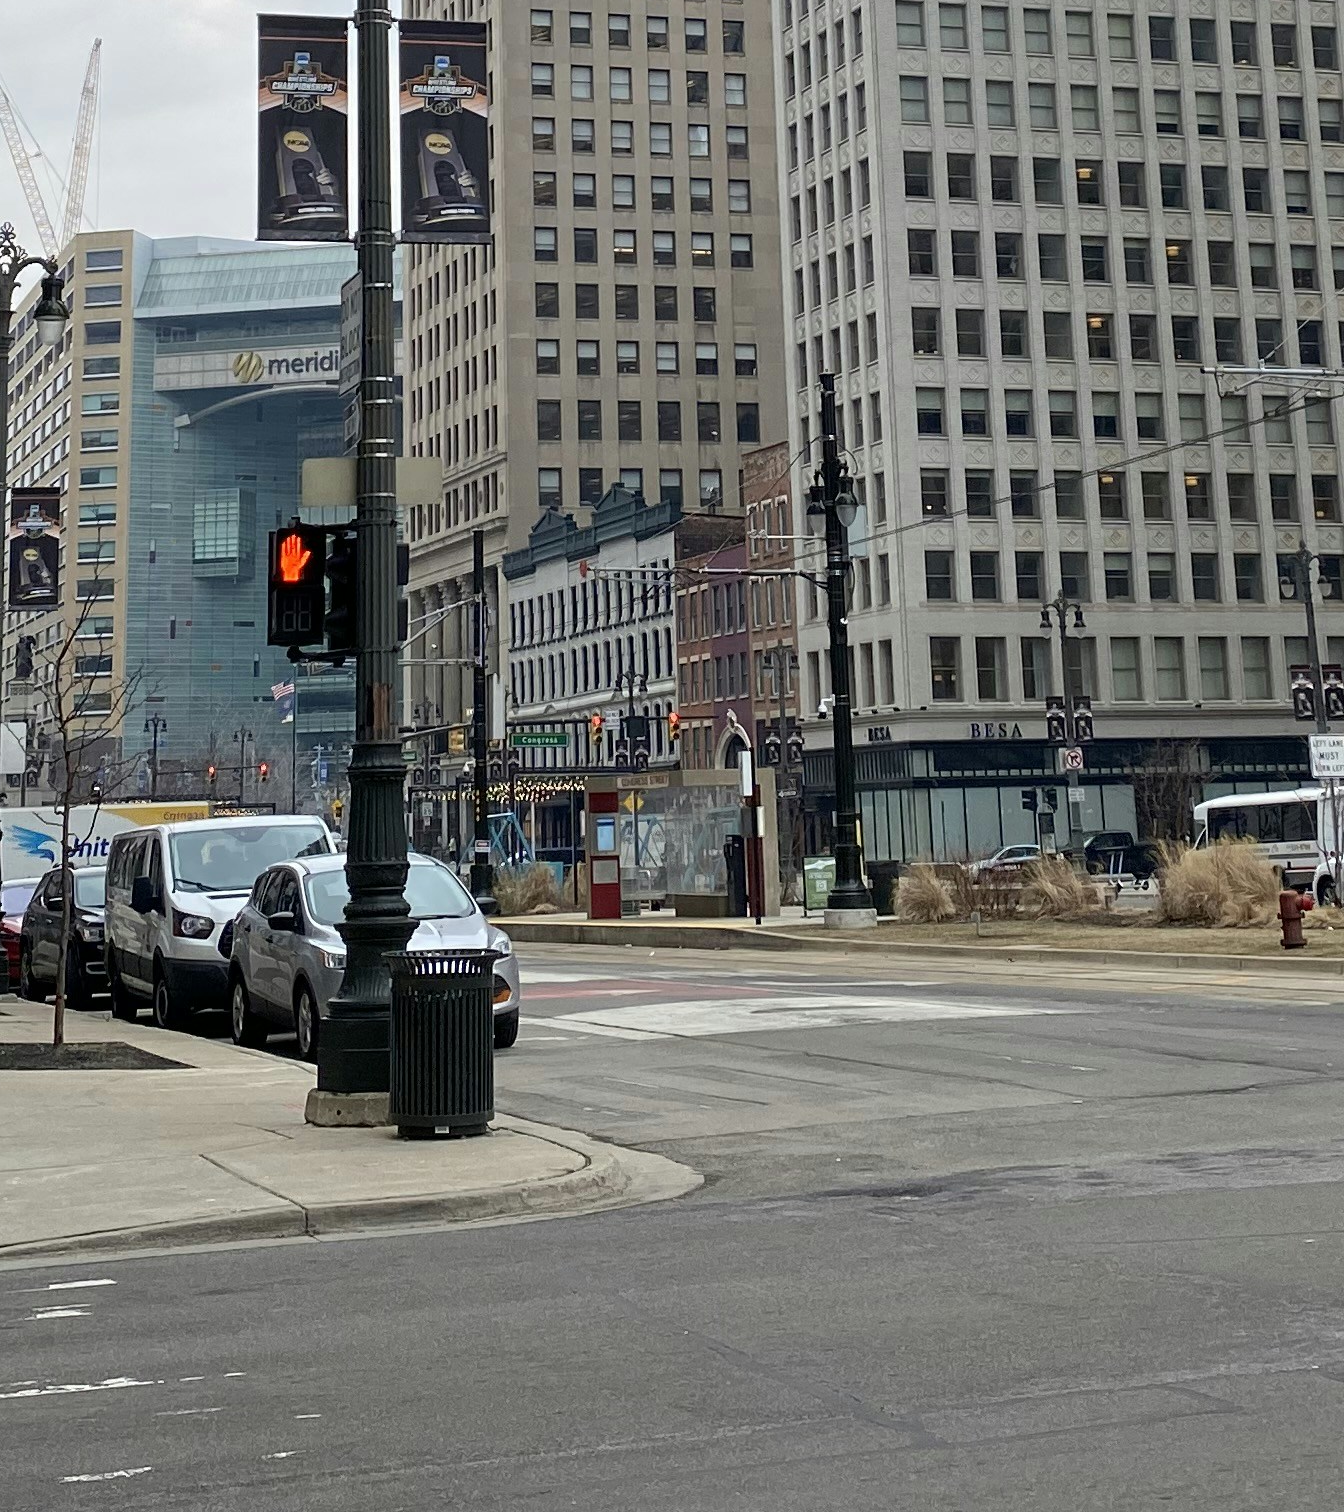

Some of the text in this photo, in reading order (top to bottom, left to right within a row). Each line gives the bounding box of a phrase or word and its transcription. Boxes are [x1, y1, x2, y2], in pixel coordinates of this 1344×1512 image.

[413, 84, 473, 95] CHAMPIONSHIPS
[268, 350, 340, 375] meridi
[868, 726, 892, 741] BESA
[970, 722, 1023, 738] BESA
[521, 736, 558, 745] Congress
[1312, 740, 1344, 748] LEFT LANE
[1319, 751, 1339, 760] MUST
[68, 836, 109, 857] Unit
